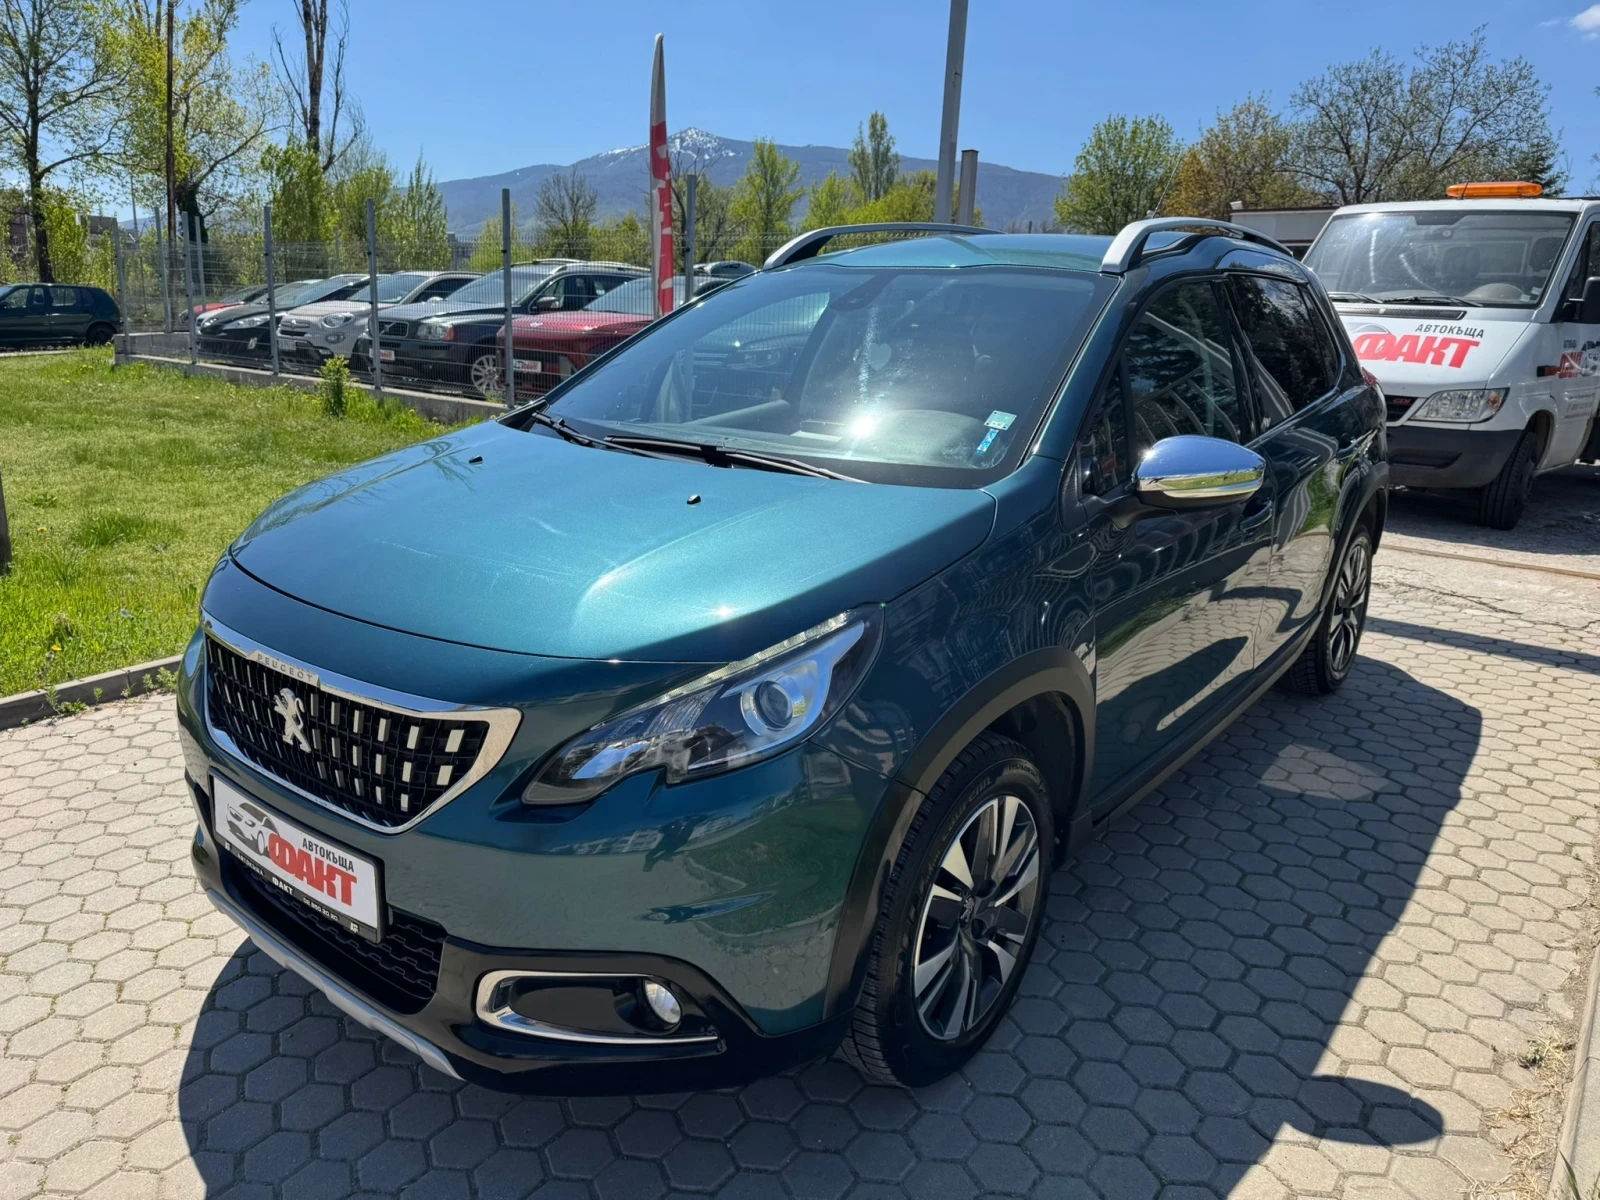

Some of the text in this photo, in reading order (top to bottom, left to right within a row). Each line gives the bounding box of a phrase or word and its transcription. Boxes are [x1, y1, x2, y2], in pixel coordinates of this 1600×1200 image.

[1415, 324, 1485, 338] АВТОКЪЩА
[1352, 333, 1480, 368] ФАКТ
[257, 653, 313, 682] PEUGEOT
[268, 833, 358, 906] ФАКТ
[302, 838, 354, 873] АВТОКЪЩА
[271, 876, 294, 896] ФАКТ
